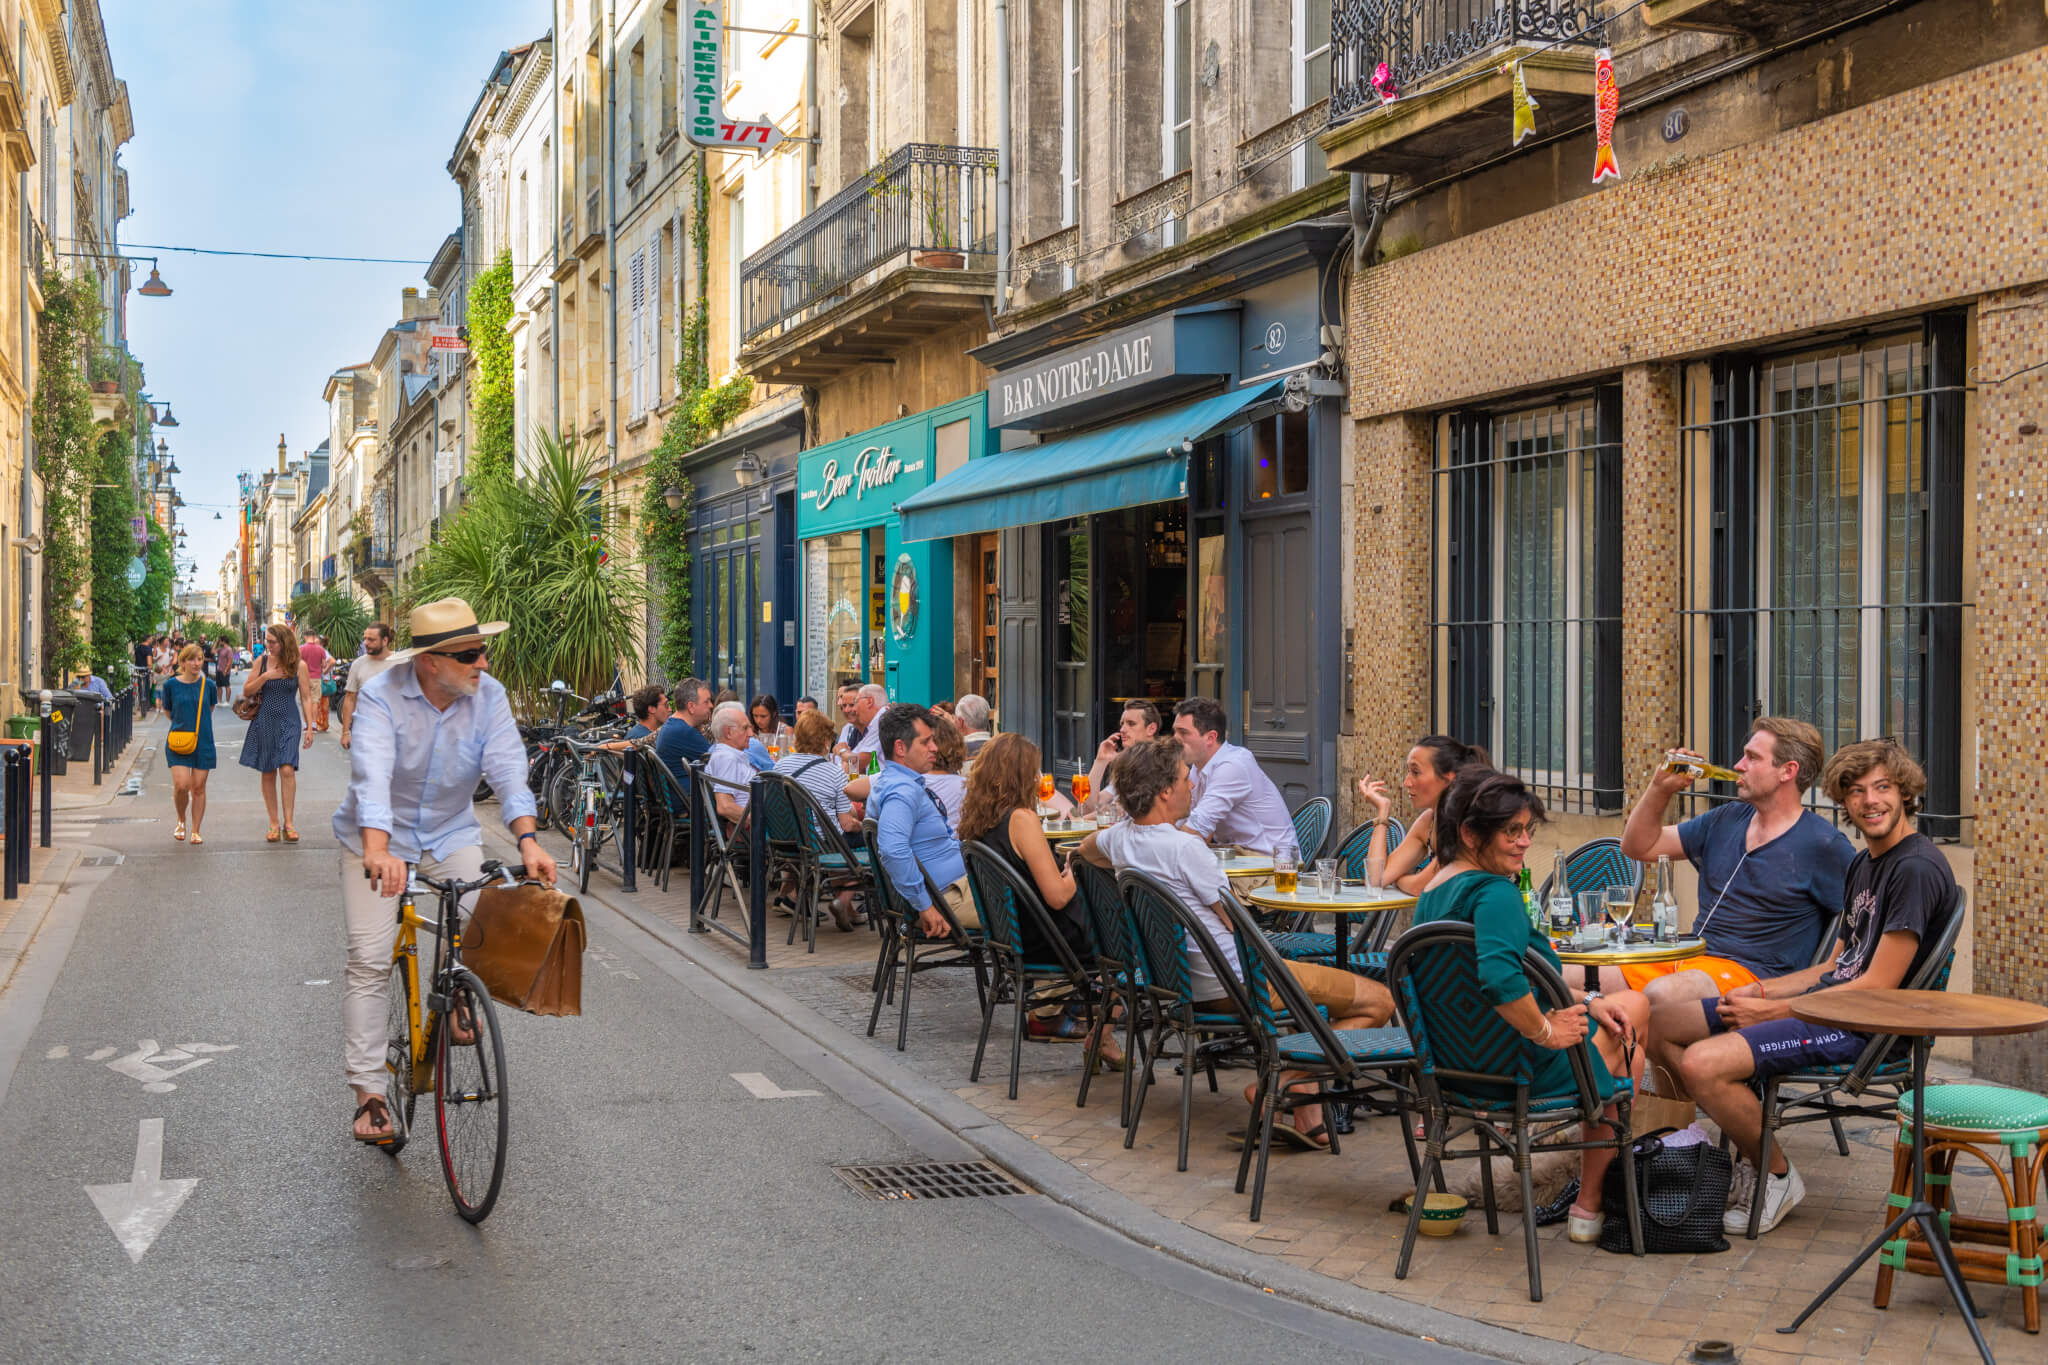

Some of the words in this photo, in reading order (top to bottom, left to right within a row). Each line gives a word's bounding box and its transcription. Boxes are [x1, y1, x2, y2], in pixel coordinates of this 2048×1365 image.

[693, 9, 717, 137] ALIMENTATION
[720, 124, 772, 143] 7/7
[1665, 112, 1683, 138] 80
[1270, 328, 1281, 349] 82
[1003, 377, 1034, 416] BAR
[816, 459, 853, 511] Beer
[854, 446, 902, 500] Trotter
[1759, 1039, 1801, 1052] HILFIGER
[1815, 1030, 1846, 1045] TOMM
